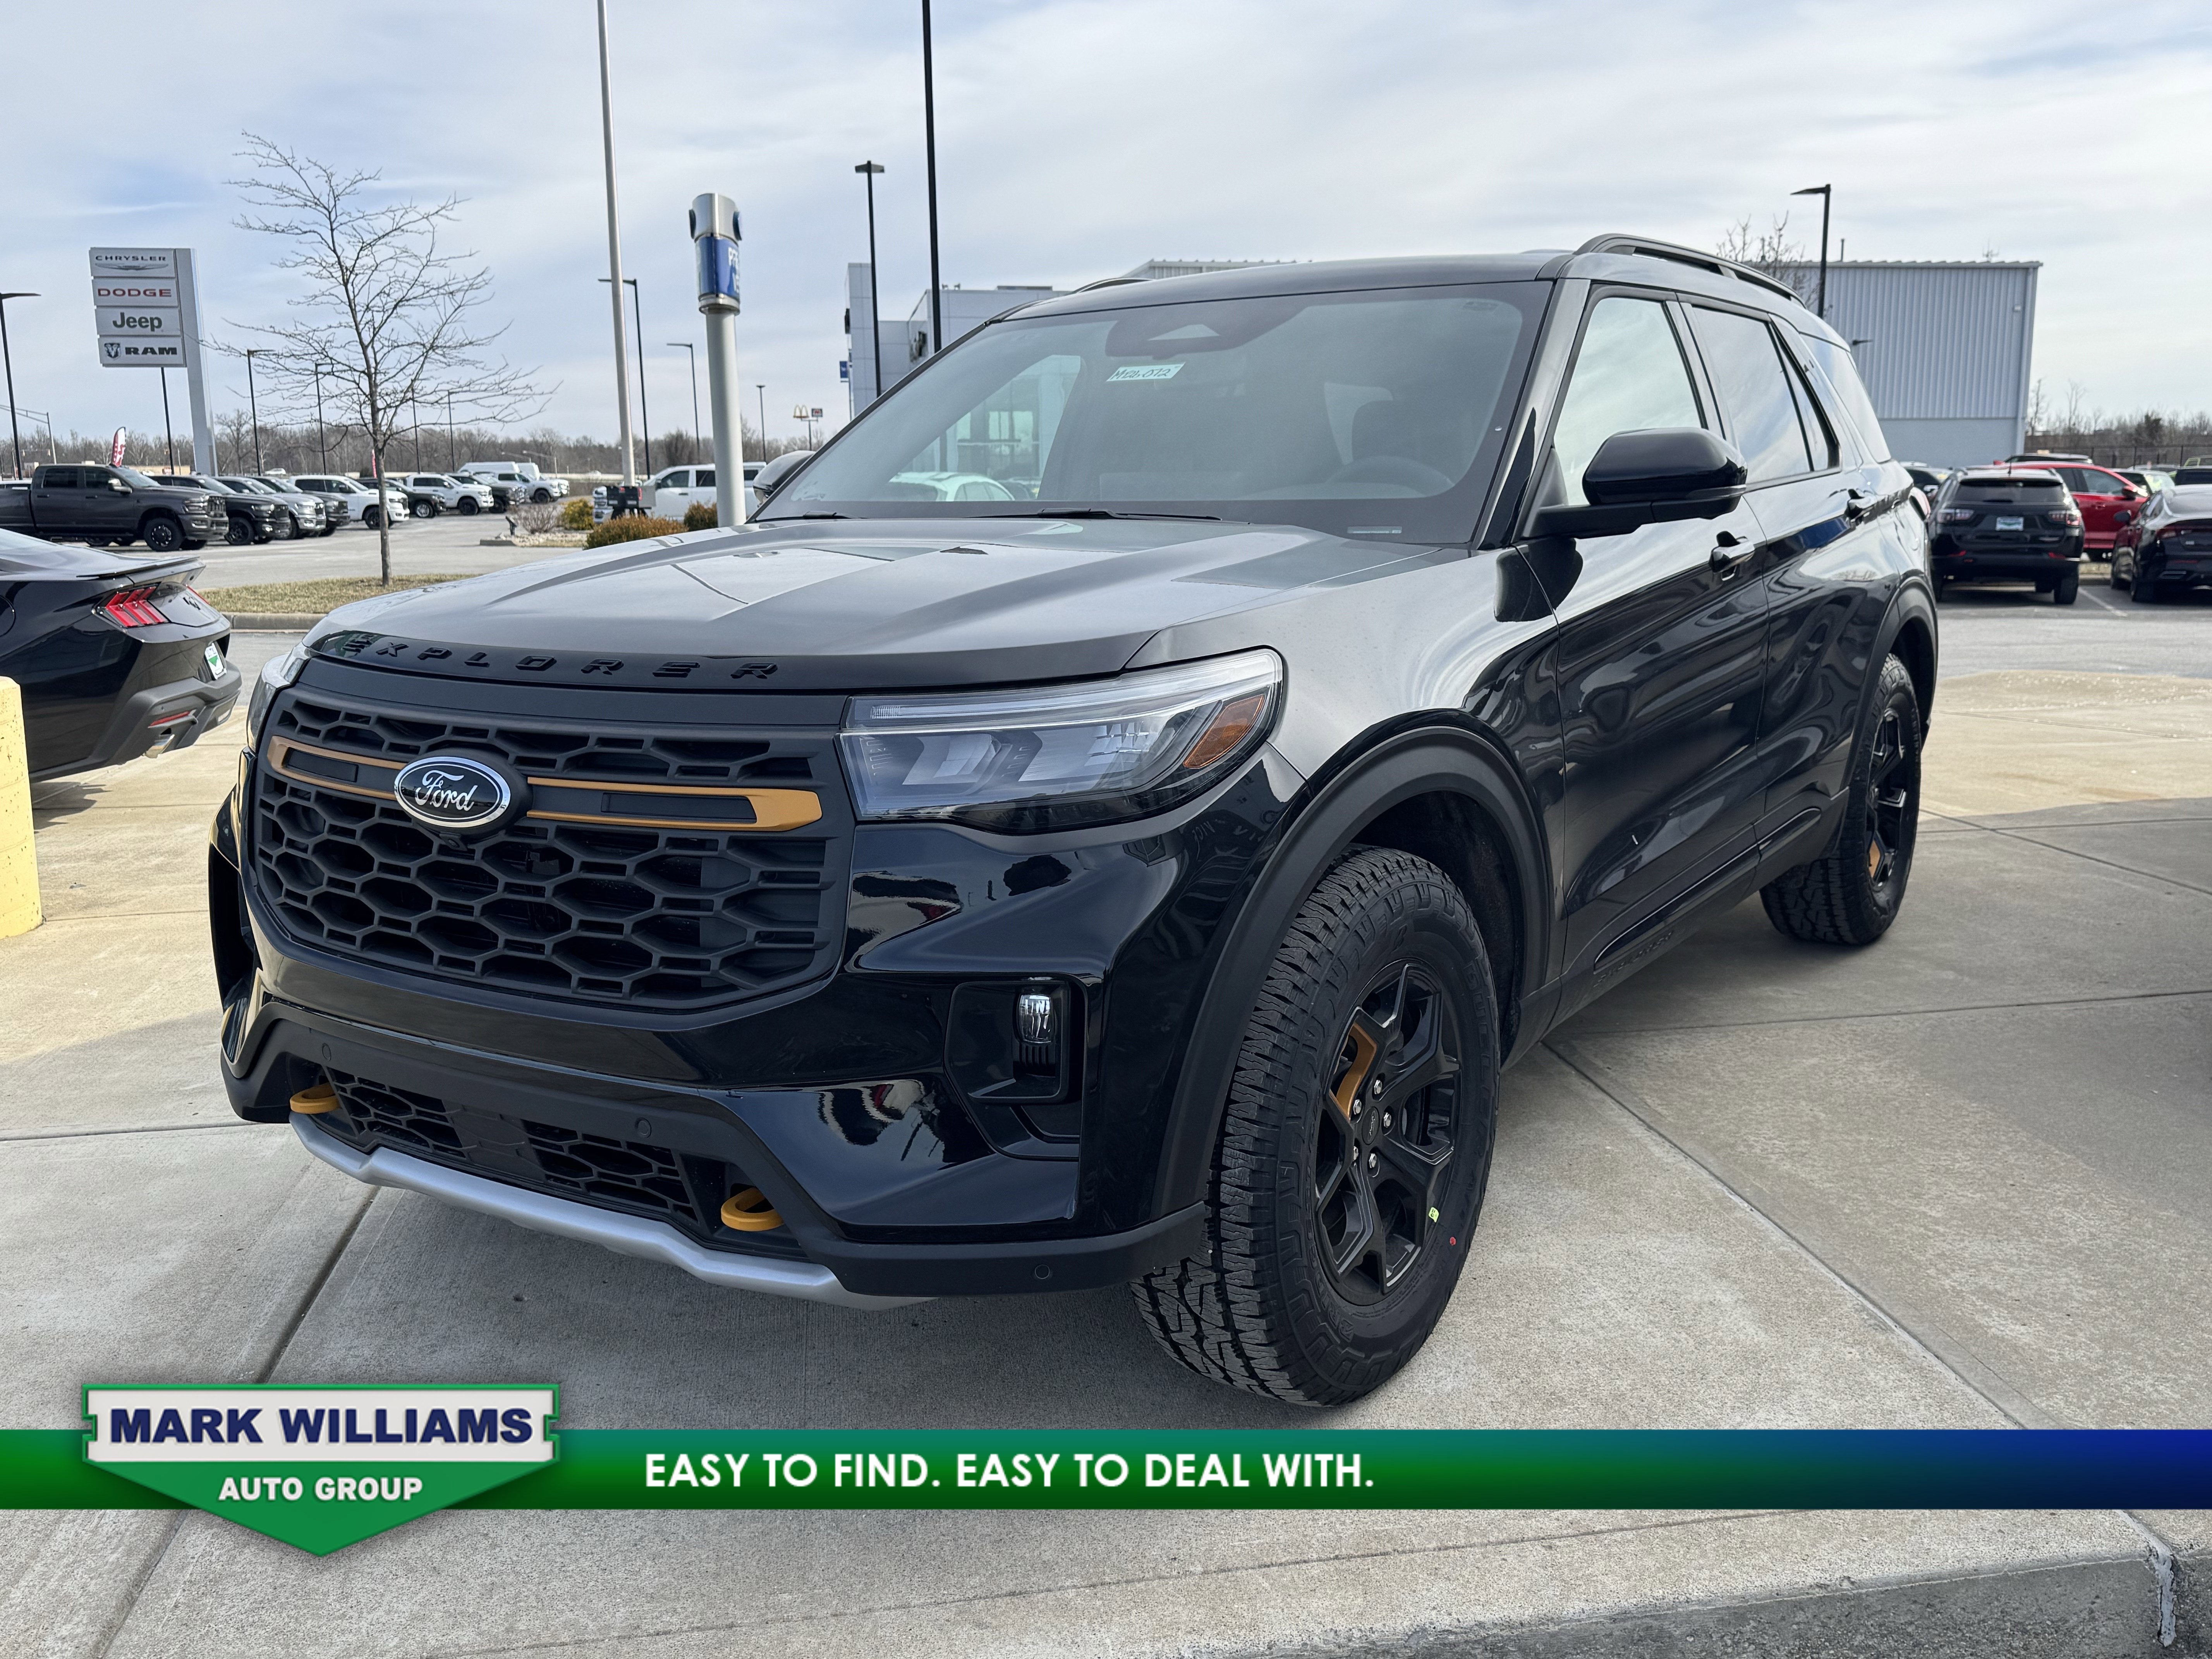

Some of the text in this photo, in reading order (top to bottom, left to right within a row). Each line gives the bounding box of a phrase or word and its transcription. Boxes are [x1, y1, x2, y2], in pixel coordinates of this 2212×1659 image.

[98, 289, 172, 297] DODGE
[112, 312, 162, 332] Jeep
[125, 347, 177, 355] RAM
[342, 634, 778, 679] EXPLORER
[414, 770, 478, 812] Ford
